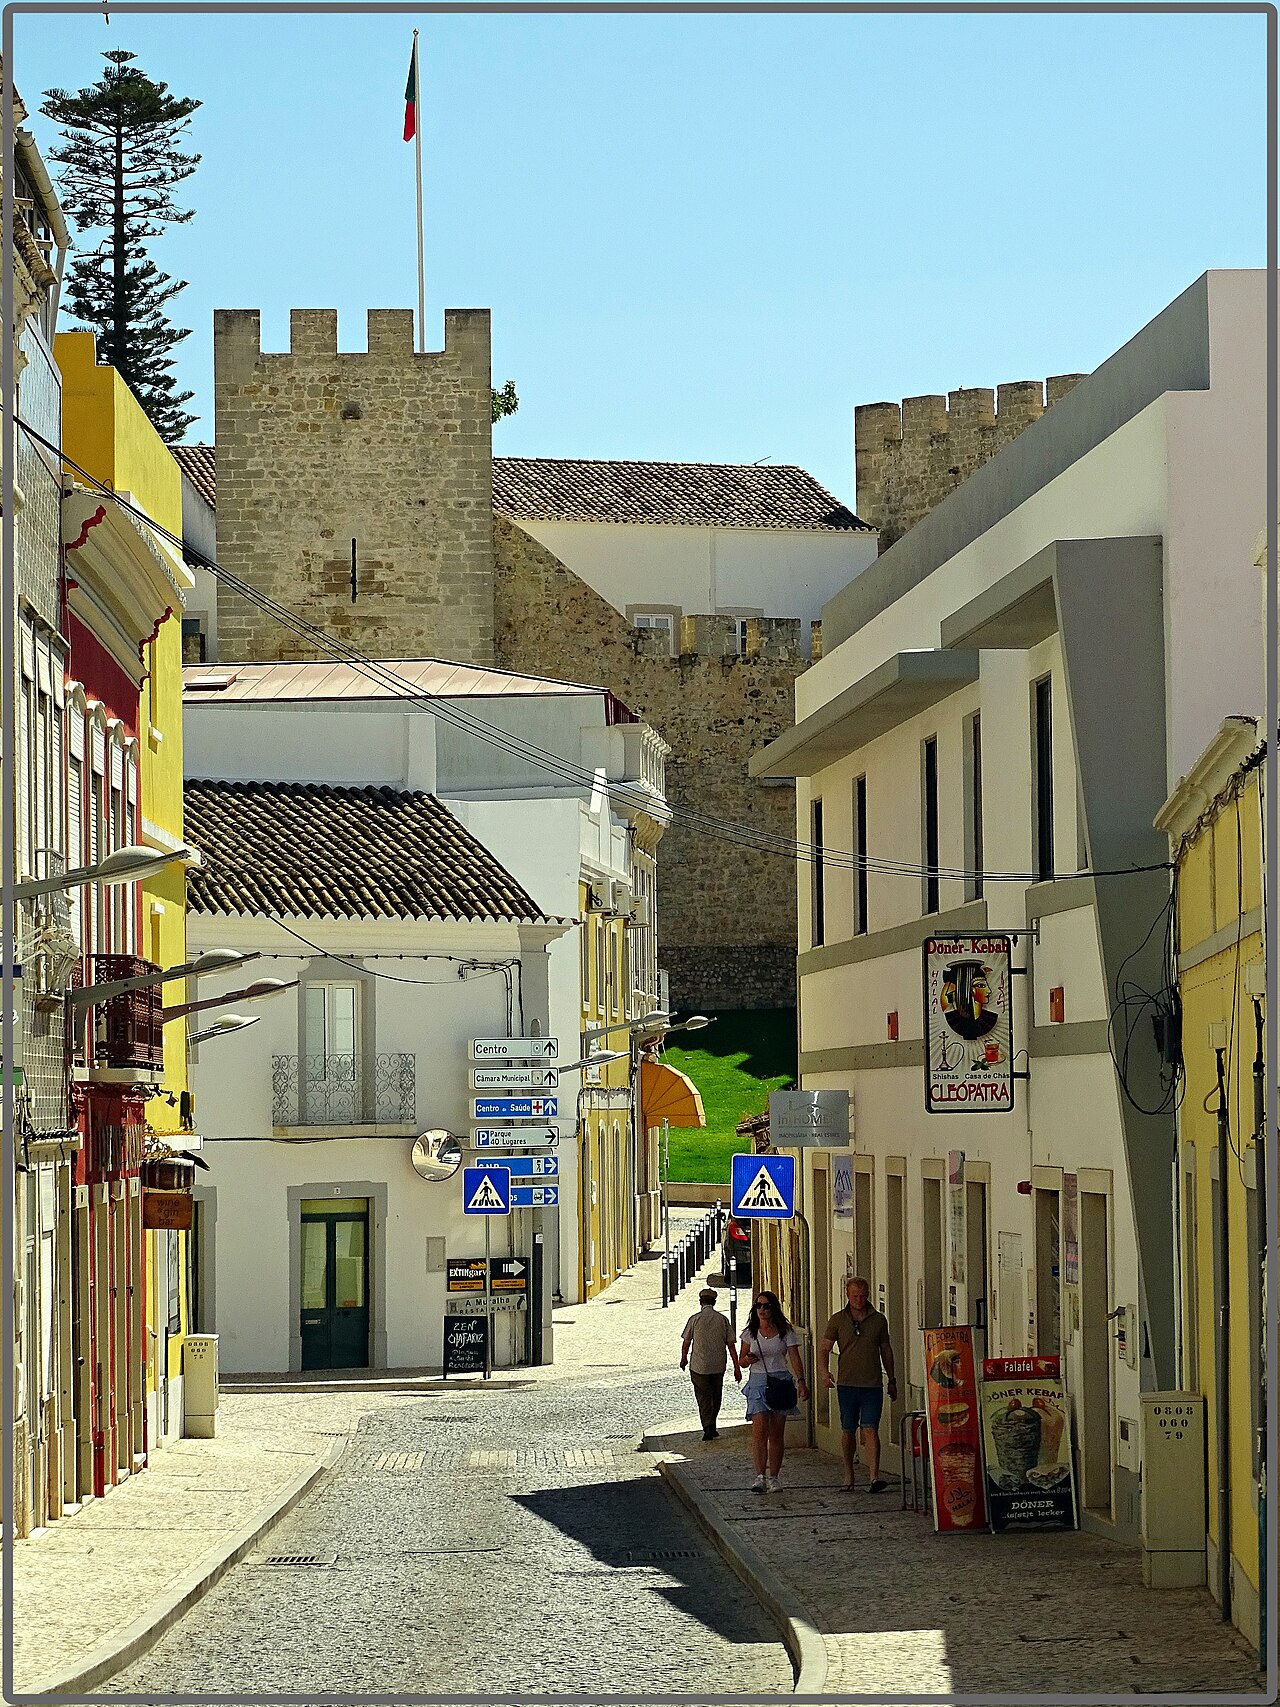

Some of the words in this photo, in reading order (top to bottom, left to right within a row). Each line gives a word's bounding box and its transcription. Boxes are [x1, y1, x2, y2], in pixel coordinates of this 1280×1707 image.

[475, 1044, 508, 1054] Centro
[476, 1074, 500, 1082] Câmara
[501, 1074, 531, 1083] Municipal
[930, 1080, 1010, 1102] CLEÓPATRA
[476, 1104, 500, 1112] Centro
[510, 1103, 531, 1112] Saúde
[479, 1131, 488, 1145] P
[490, 1130, 512, 1138] Parque
[490, 1138, 500, 1146] 40
[502, 1138, 527, 1147] Lugares
[156, 1199, 180, 1207] wine
[164, 1208, 179, 1219] gin
[159, 1216, 175, 1226] bar
[449, 1267, 491, 1278] EXTINgarv
[465, 1299, 472, 1307] A
[475, 1296, 510, 1306] Mualha
[453, 1320, 478, 1331] ZEN
[1004, 1360, 1034, 1373] Falafel
[1153, 1406, 1194, 1415] 0808
[1159, 1418, 1189, 1428] 060
[1164, 1431, 1184, 1440] 79
[1011, 1499, 1055, 1510] DÖNER
